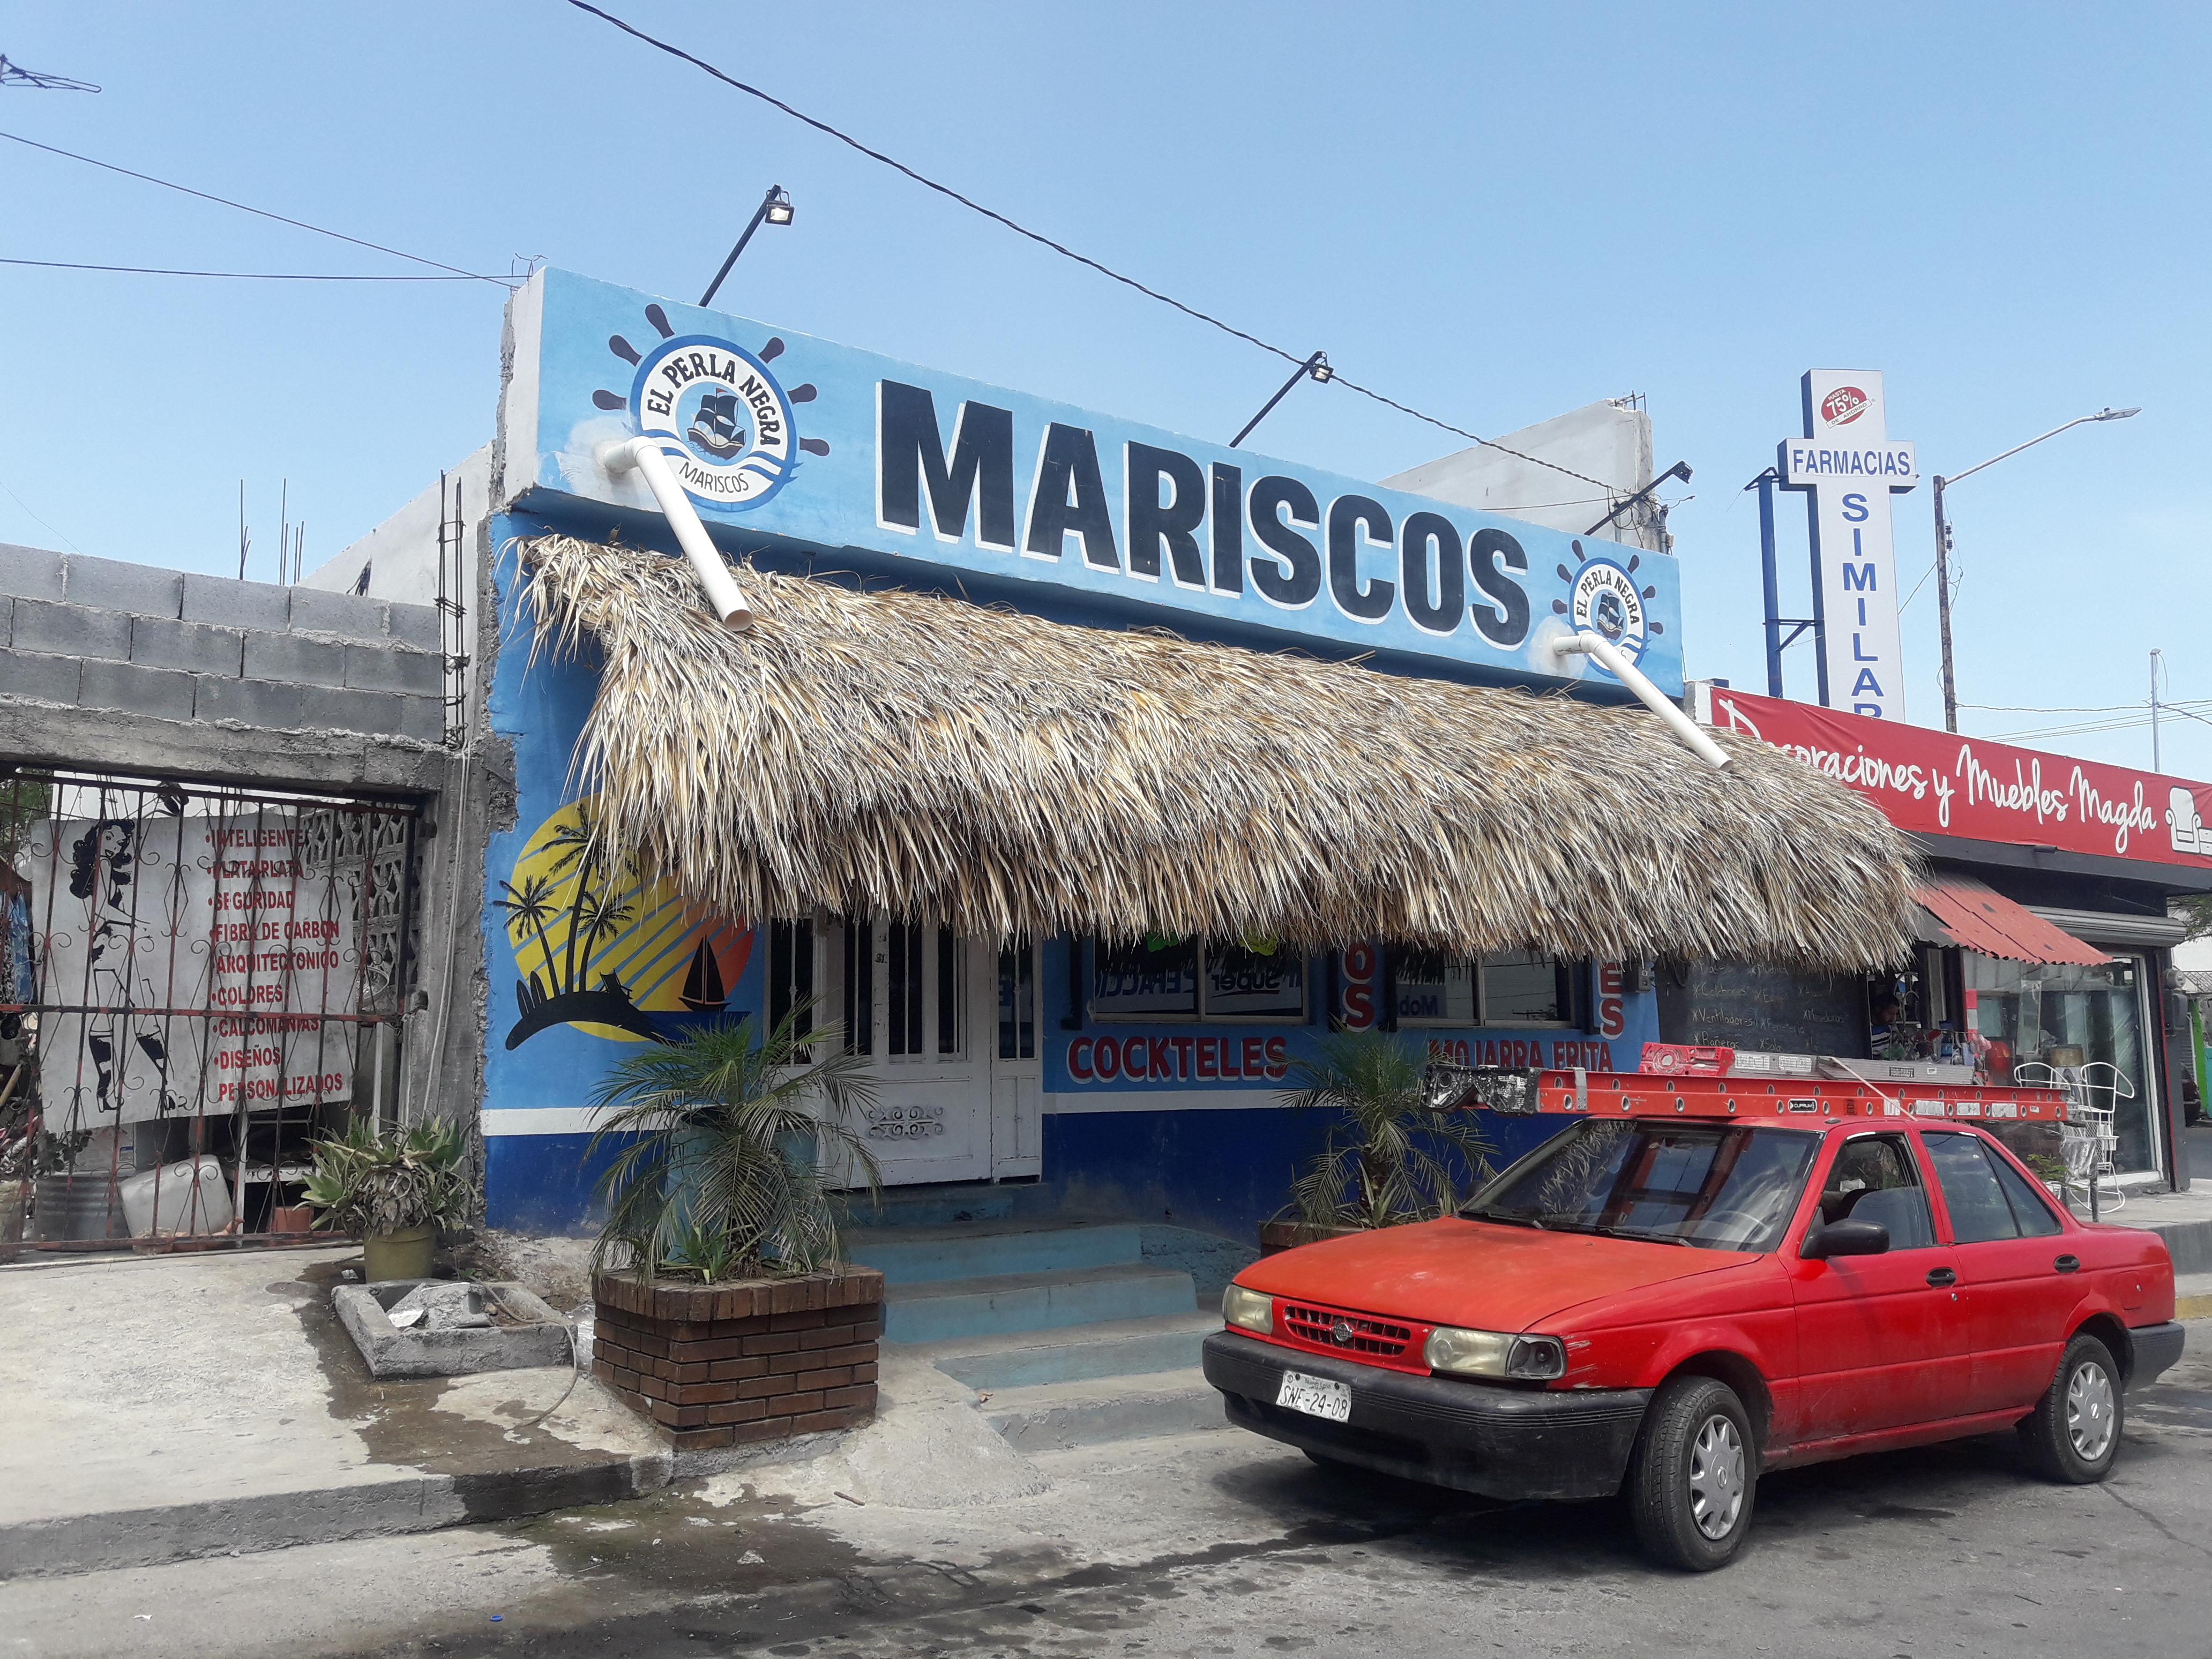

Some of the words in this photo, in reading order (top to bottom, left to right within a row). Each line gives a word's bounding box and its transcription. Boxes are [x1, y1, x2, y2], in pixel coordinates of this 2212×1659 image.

[647, 389, 673, 417] EL
[662, 353, 736, 388] PERLA
[739, 375, 781, 445] NEGRA
[1826, 391, 1859, 416] 75%
[1828, 389, 1846, 400] HASTA
[1843, 402, 1867, 419] AHORRO
[1792, 449, 1910, 476] FARMACIAS
[679, 461, 749, 494] MARISCOS
[877, 378, 1530, 650] MARISCOS
[1581, 570, 1612, 597] PERLA
[1576, 599, 1588, 618] EL
[1614, 576, 1640, 625] NEGRA
[1718, 698, 1928, 800] Doraciones
[1932, 768, 1955, 828] y
[1956, 744, 2068, 825] Muebles
[2069, 765, 2157, 854] Magda
[212, 829, 305, 847] INTELIGENTE
[216, 891, 294, 910] SEGURIDAD
[215, 923, 256, 941] FIBR
[263, 922, 280, 940] DE
[285, 921, 339, 939] CARBON
[217, 951, 339, 974] ARQUITECONICO
[218, 984, 283, 1005] COLORES
[220, 1044, 281, 1069] DISEÑOS
[1066, 1036, 1288, 1085] COCKTELES
[219, 1073, 342, 1101] PESONLIZAOS
